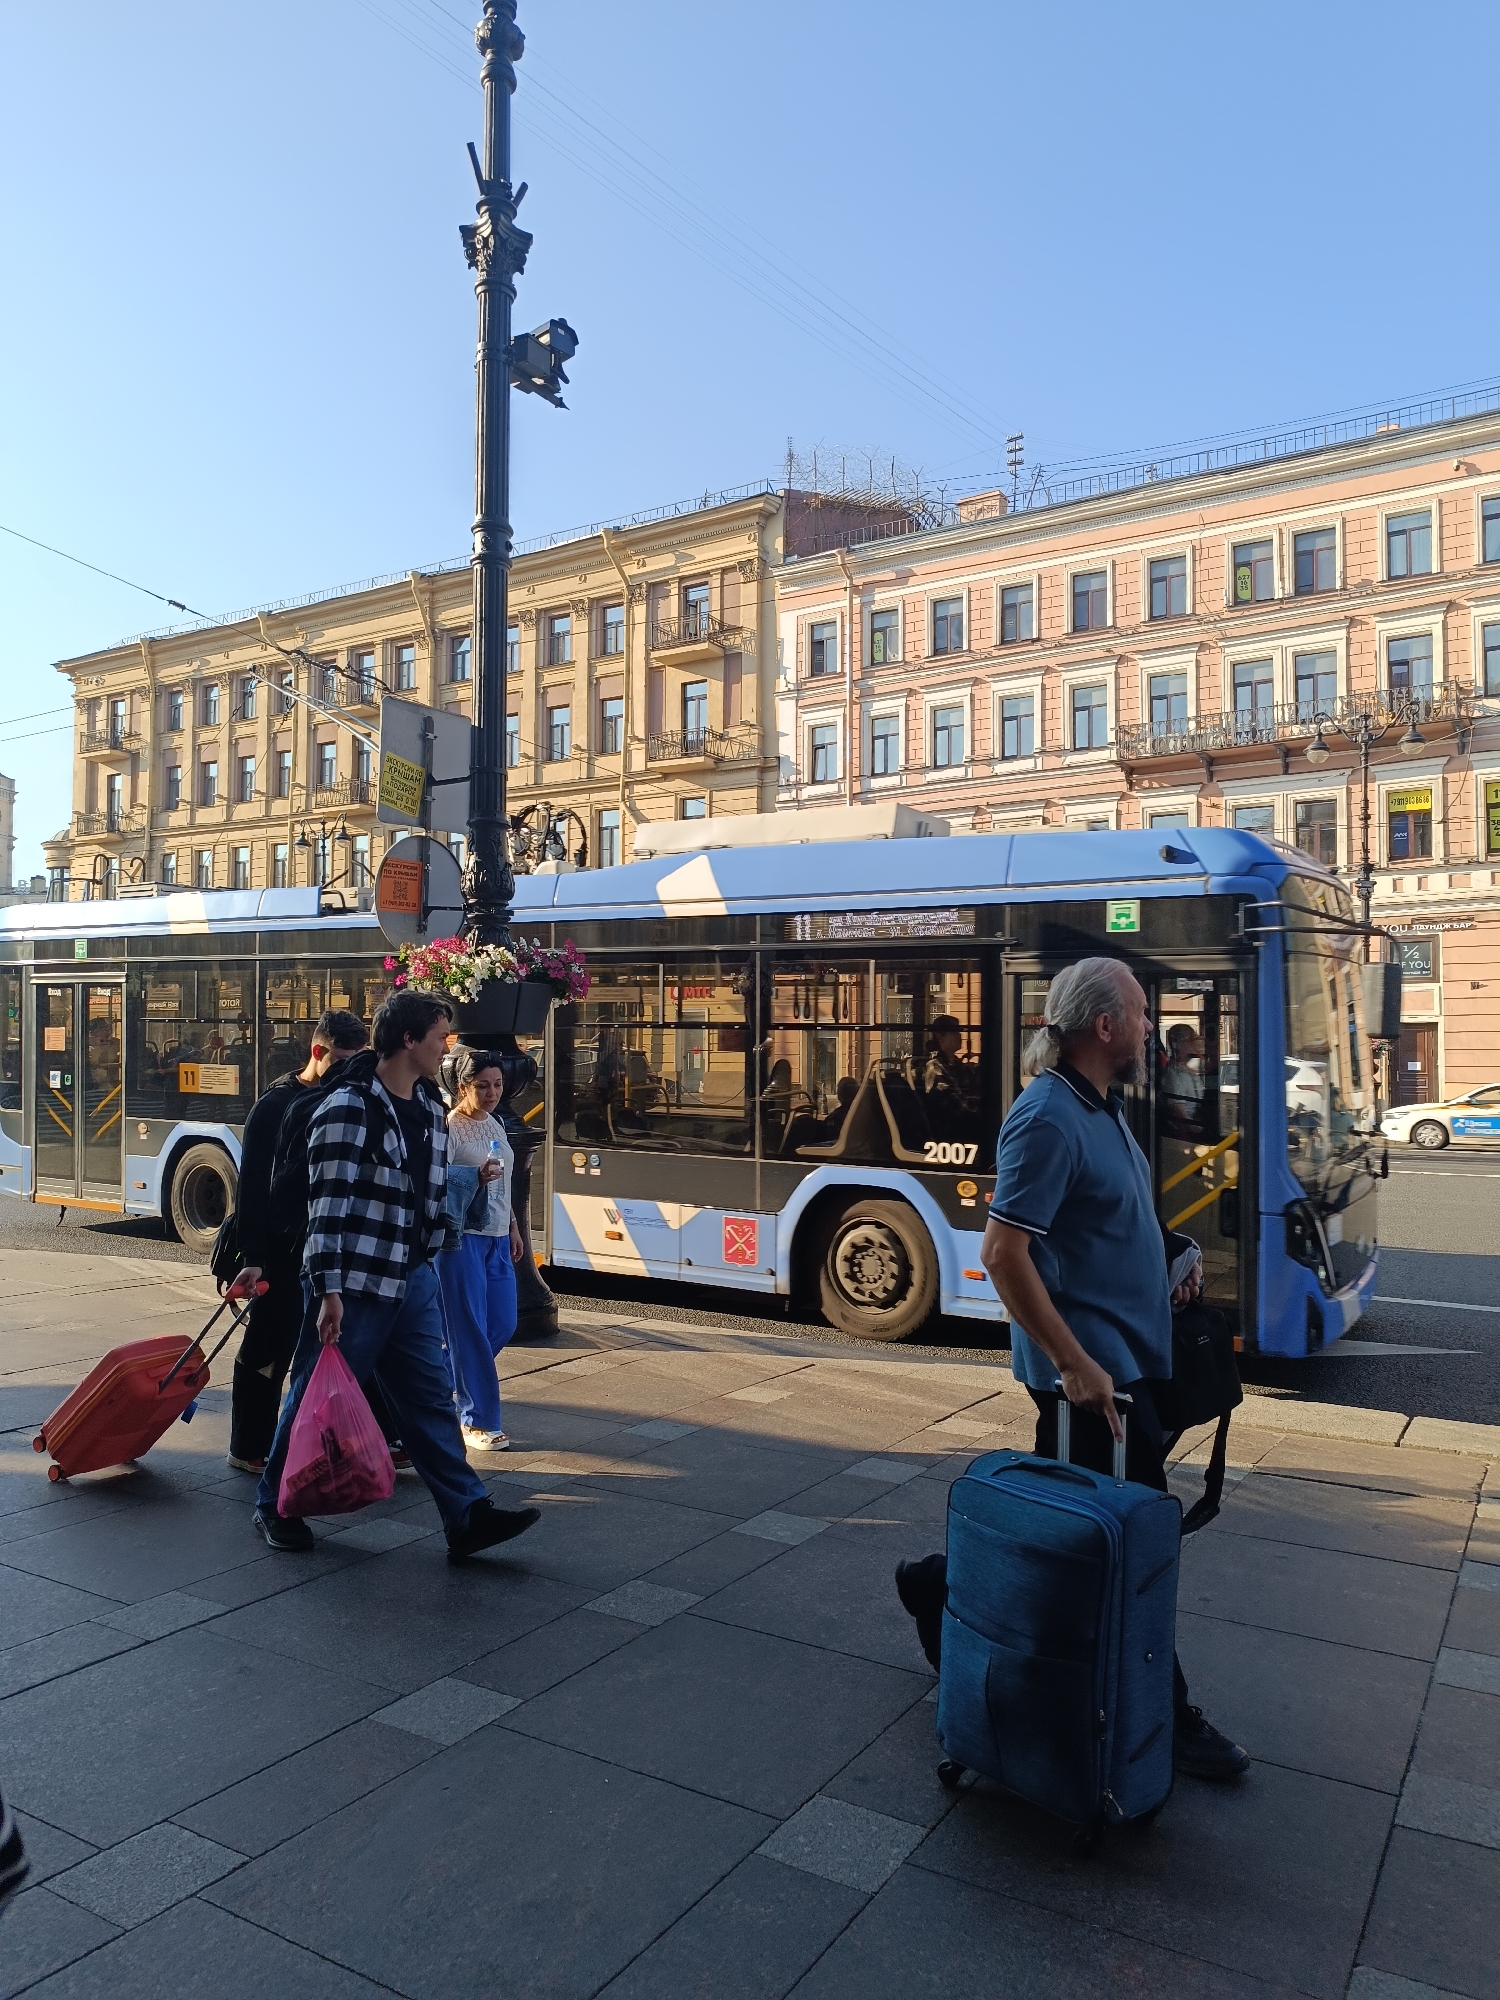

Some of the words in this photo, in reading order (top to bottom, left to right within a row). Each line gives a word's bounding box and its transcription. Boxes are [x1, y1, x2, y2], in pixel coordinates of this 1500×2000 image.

[388, 764, 421, 785] КРЫШАМ
[794, 914, 811, 940] 11
[1382, 924, 1408, 933] YOU
[1408, 960, 1430, 968] YOU
[48, 988, 62, 996] Вход
[97, 987, 111, 996] Вход
[184, 1070, 195, 1086] 11
[924, 1142, 978, 1164] 2007
